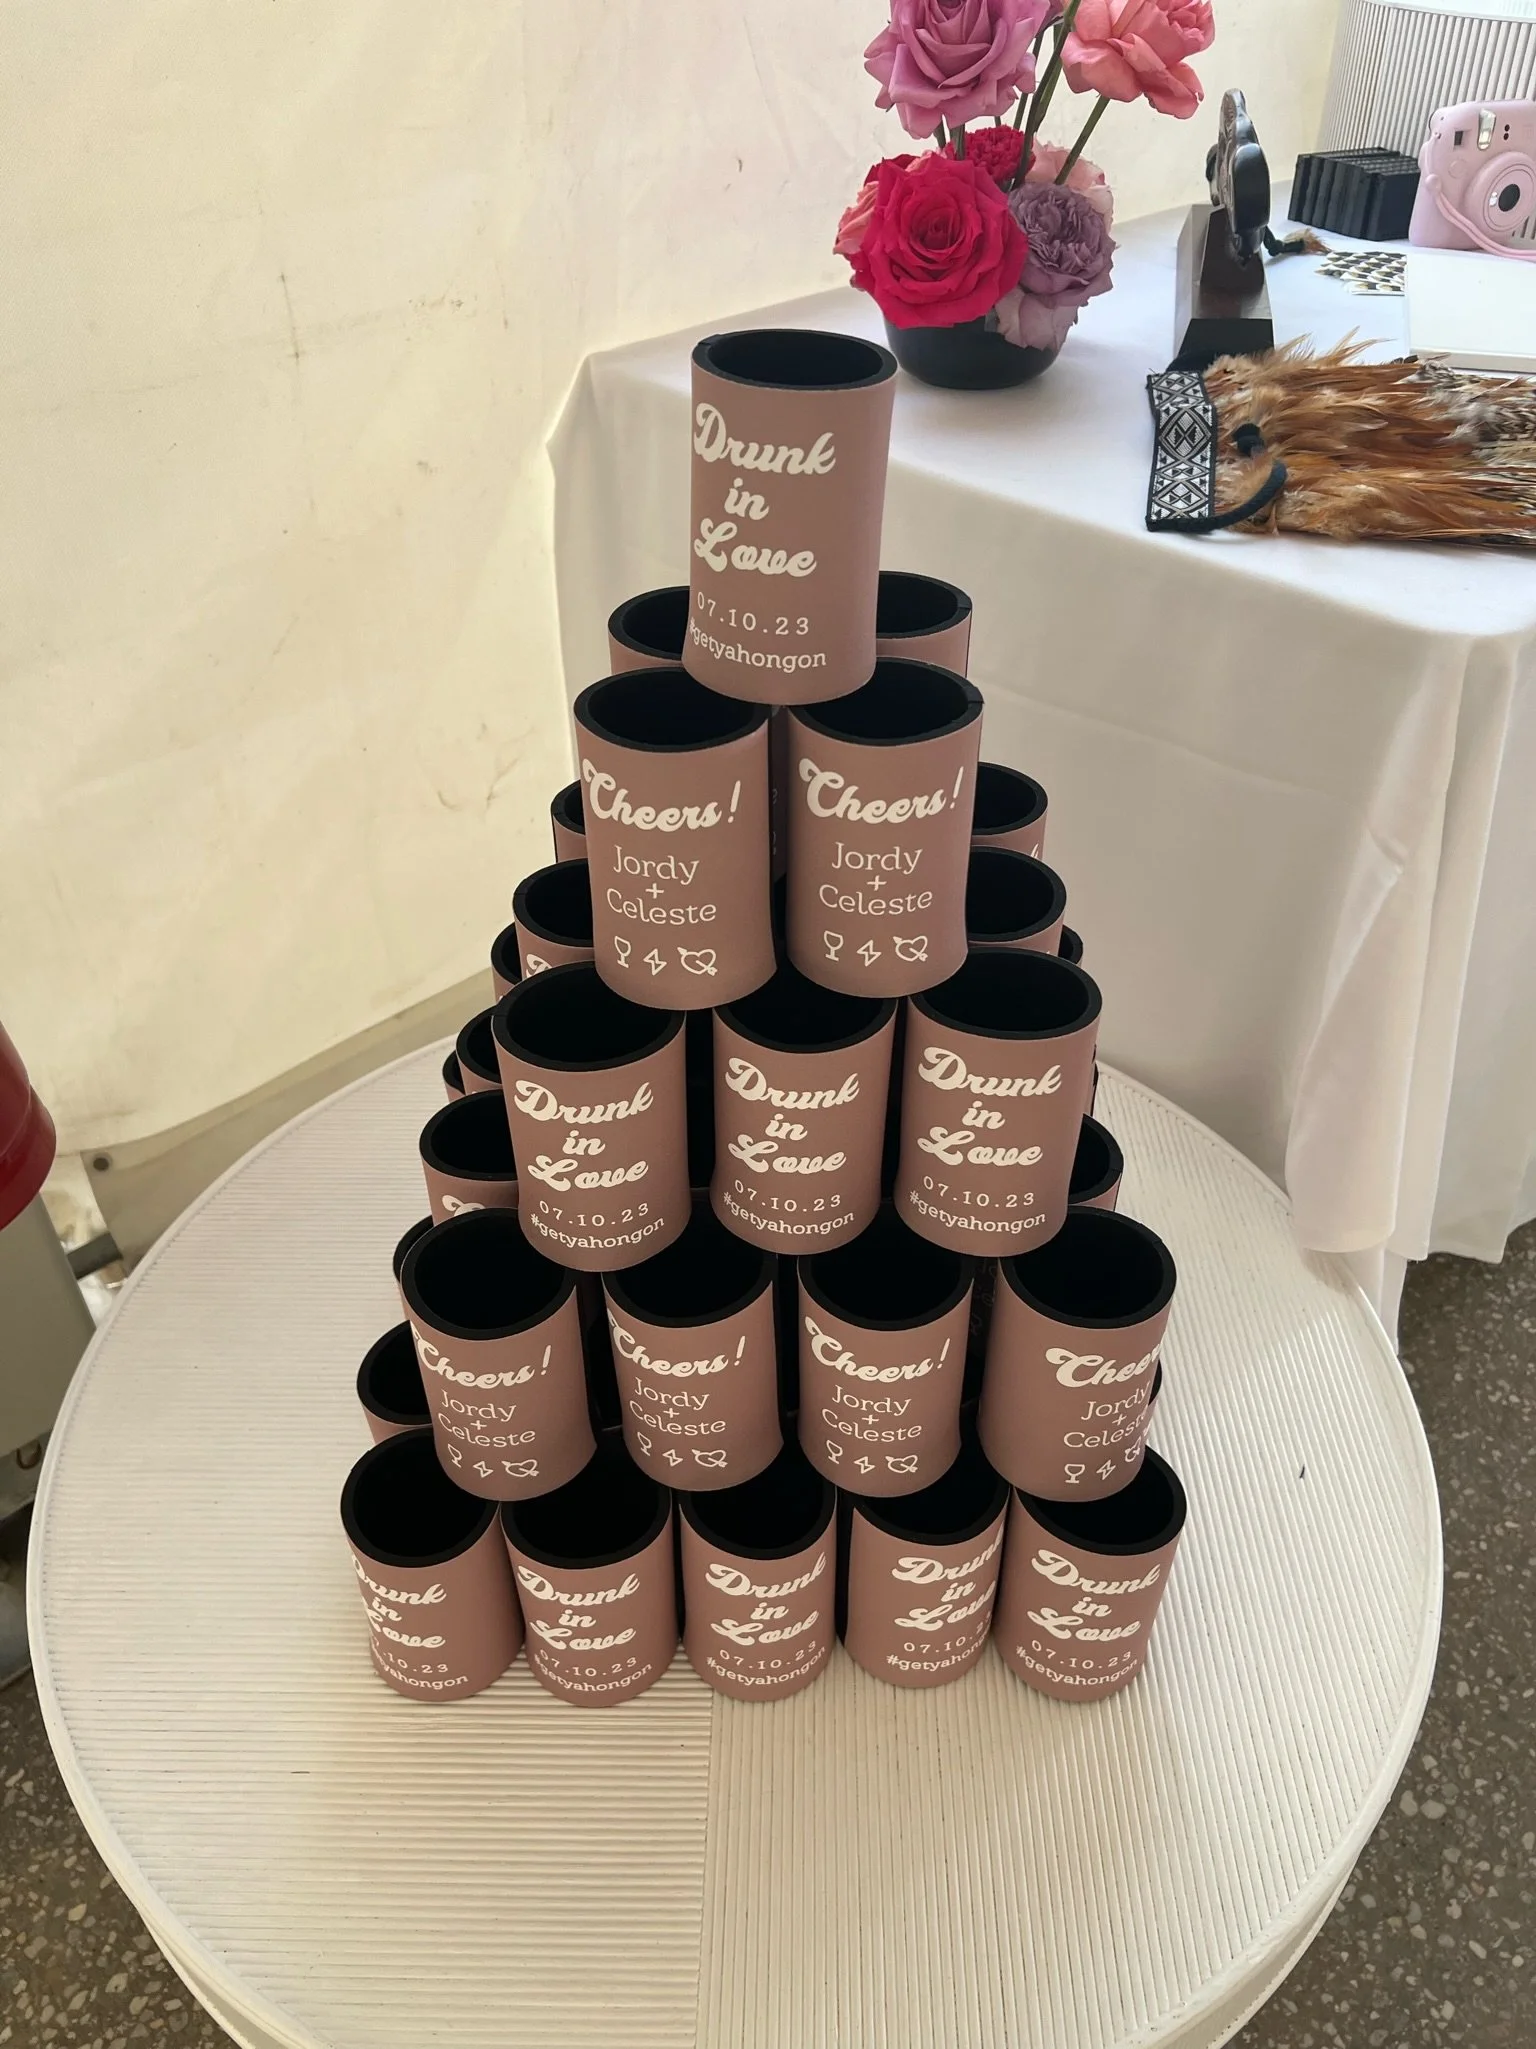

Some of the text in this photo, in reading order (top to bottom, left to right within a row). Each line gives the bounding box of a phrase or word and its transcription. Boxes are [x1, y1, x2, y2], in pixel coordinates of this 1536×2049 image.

[694, 402, 836, 475] Drunk
[724, 478, 769, 520] in
[694, 518, 816, 577] Love
[697, 592, 809, 636] 07.10.23
[582, 758, 741, 832] Cheers!
[798, 758, 964, 824] Cheers!
[613, 844, 700, 886] Jordy
[832, 842, 922, 874] Jordy
[646, 883, 664, 898] +
[819, 884, 932, 915] Celeste
[867, 875, 887, 891] +
[606, 888, 716, 925] Celeste
[725, 1058, 860, 1110] Drunk
[918, 1047, 1062, 1096] Drunk
[514, 1080, 654, 1124] Drunk
[962, 1100, 1005, 1130] in
[562, 1130, 606, 1155] in
[765, 1114, 808, 1140] in
[728, 1134, 846, 1174] Love
[917, 1126, 1043, 1166] Love
[528, 1154, 648, 1192] Love
[734, 1180, 841, 1212] 07.10.23
[924, 1176, 1034, 1208] 07.10.23
[540, 1200, 649, 1226] 07.10.23
[724, 1192, 854, 1234] #getyahongon
[910, 1190, 1046, 1234] #getyahongon
[530, 1213, 664, 1248] #getyahongon
[410, 1320, 551, 1389] Cheers!
[606, 1308, 746, 1377] Cheers!
[805, 1316, 950, 1382] Cheers!
[1046, 1344, 1160, 1387] Cheer
[441, 1389, 516, 1422] Jordy
[634, 1376, 710, 1410] Jordy
[832, 1384, 912, 1416] Jordy
[1081, 1380, 1150, 1420] Jordy
[438, 1413, 536, 1447] Celeste
[471, 1420, 486, 1430] +
[630, 1400, 726, 1436] Celeste
[664, 1408, 679, 1418] +
[822, 1408, 922, 1442] Celeste
[862, 1415, 879, 1425] +
[1112, 1414, 1127, 1426] +
[517, 1566, 640, 1606] Drunk
[705, 1552, 826, 1598] Drunk
[1032, 1550, 1160, 1594] Drunk
[372, 1596, 402, 1622] in
[941, 1582, 976, 1602] in
[1072, 1597, 1112, 1617] in
[558, 1610, 596, 1628] in
[710, 1610, 819, 1646] Love
[750, 1602, 789, 1620] in
[1027, 1608, 1141, 1641] Love
[530, 1620, 636, 1650] Love
[540, 1650, 636, 1676] 07.10.23
[706, 1646, 826, 1686] #getyahongon
[720, 1640, 816, 1670] 07.10.23
[1016, 1645, 1137, 1685] #getyahongon
[1032, 1640, 1131, 1669] 07.10.23
